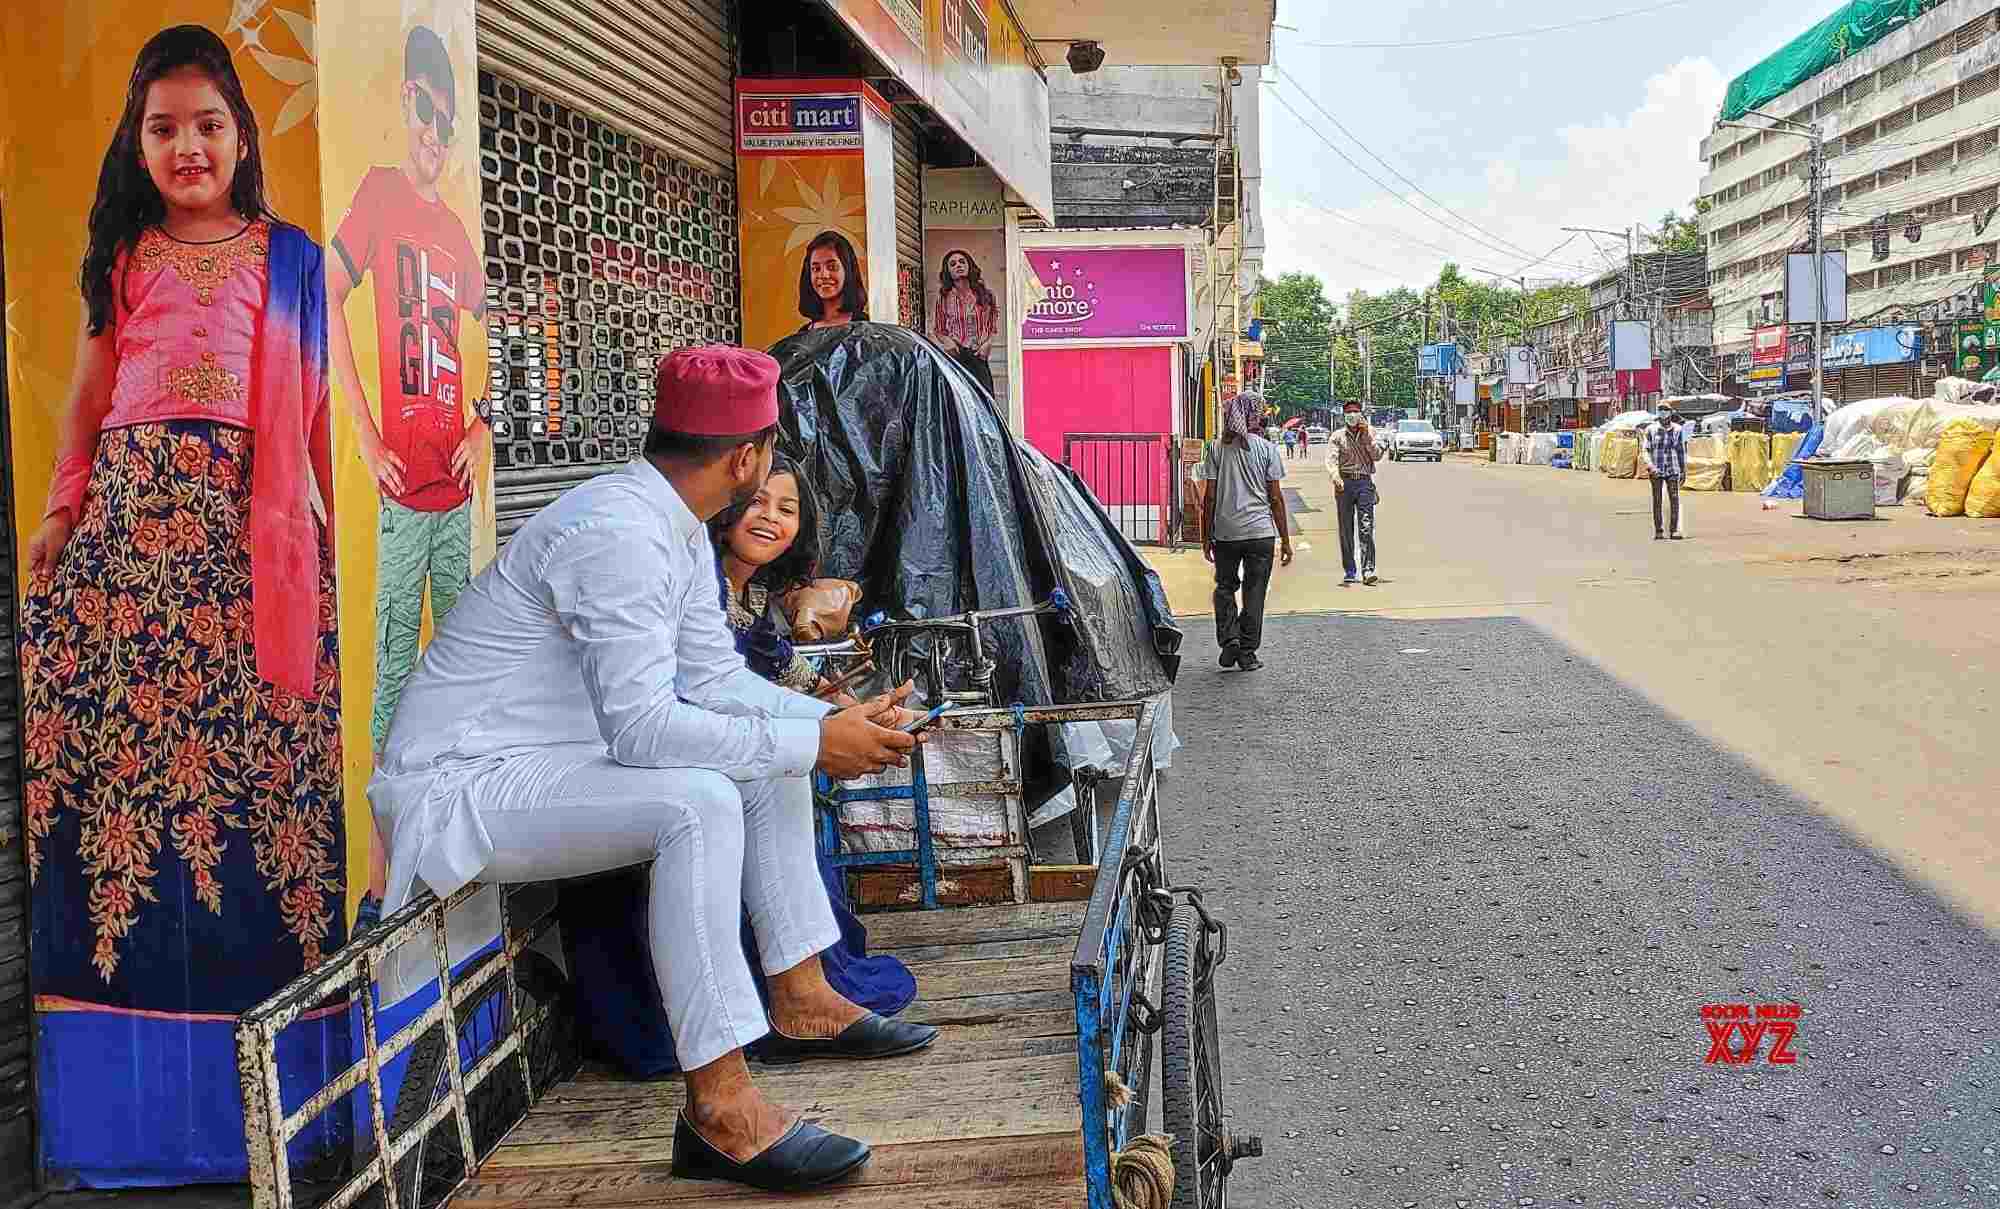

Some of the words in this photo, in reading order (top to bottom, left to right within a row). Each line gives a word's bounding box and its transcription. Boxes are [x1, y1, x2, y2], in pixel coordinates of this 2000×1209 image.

[750, 101, 788, 127] citi
[796, 104, 854, 126] mart
[1030, 299, 1089, 316] more
